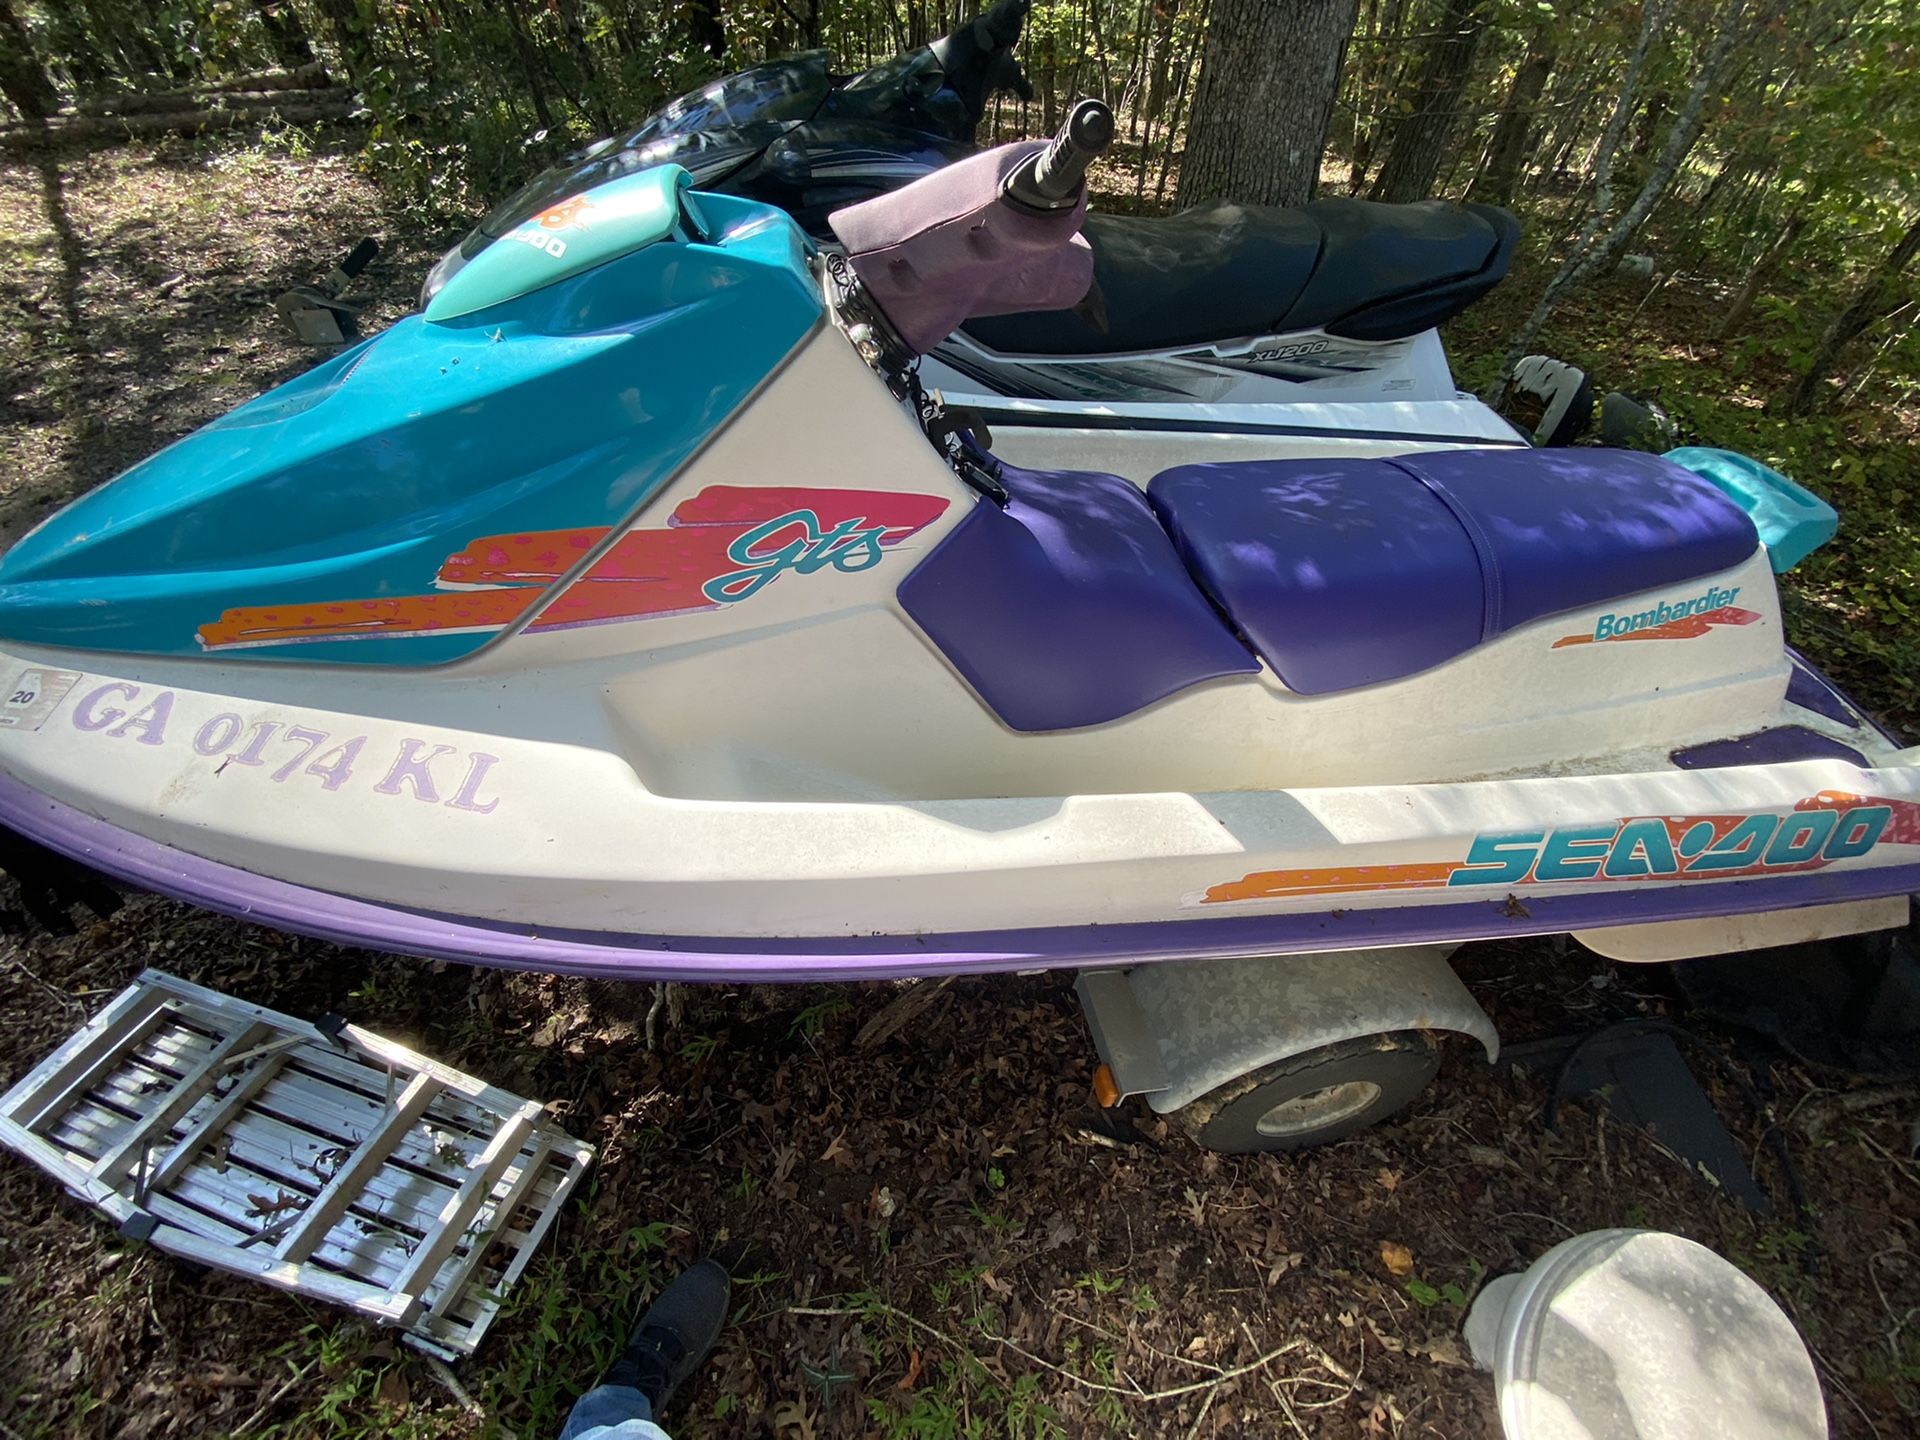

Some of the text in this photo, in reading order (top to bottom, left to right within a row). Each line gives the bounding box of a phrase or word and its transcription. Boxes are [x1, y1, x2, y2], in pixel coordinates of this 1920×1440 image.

[1594, 586, 1741, 641] Bombardier
[9, 690, 35, 703] 20
[72, 682, 500, 814] GA 0174 KL
